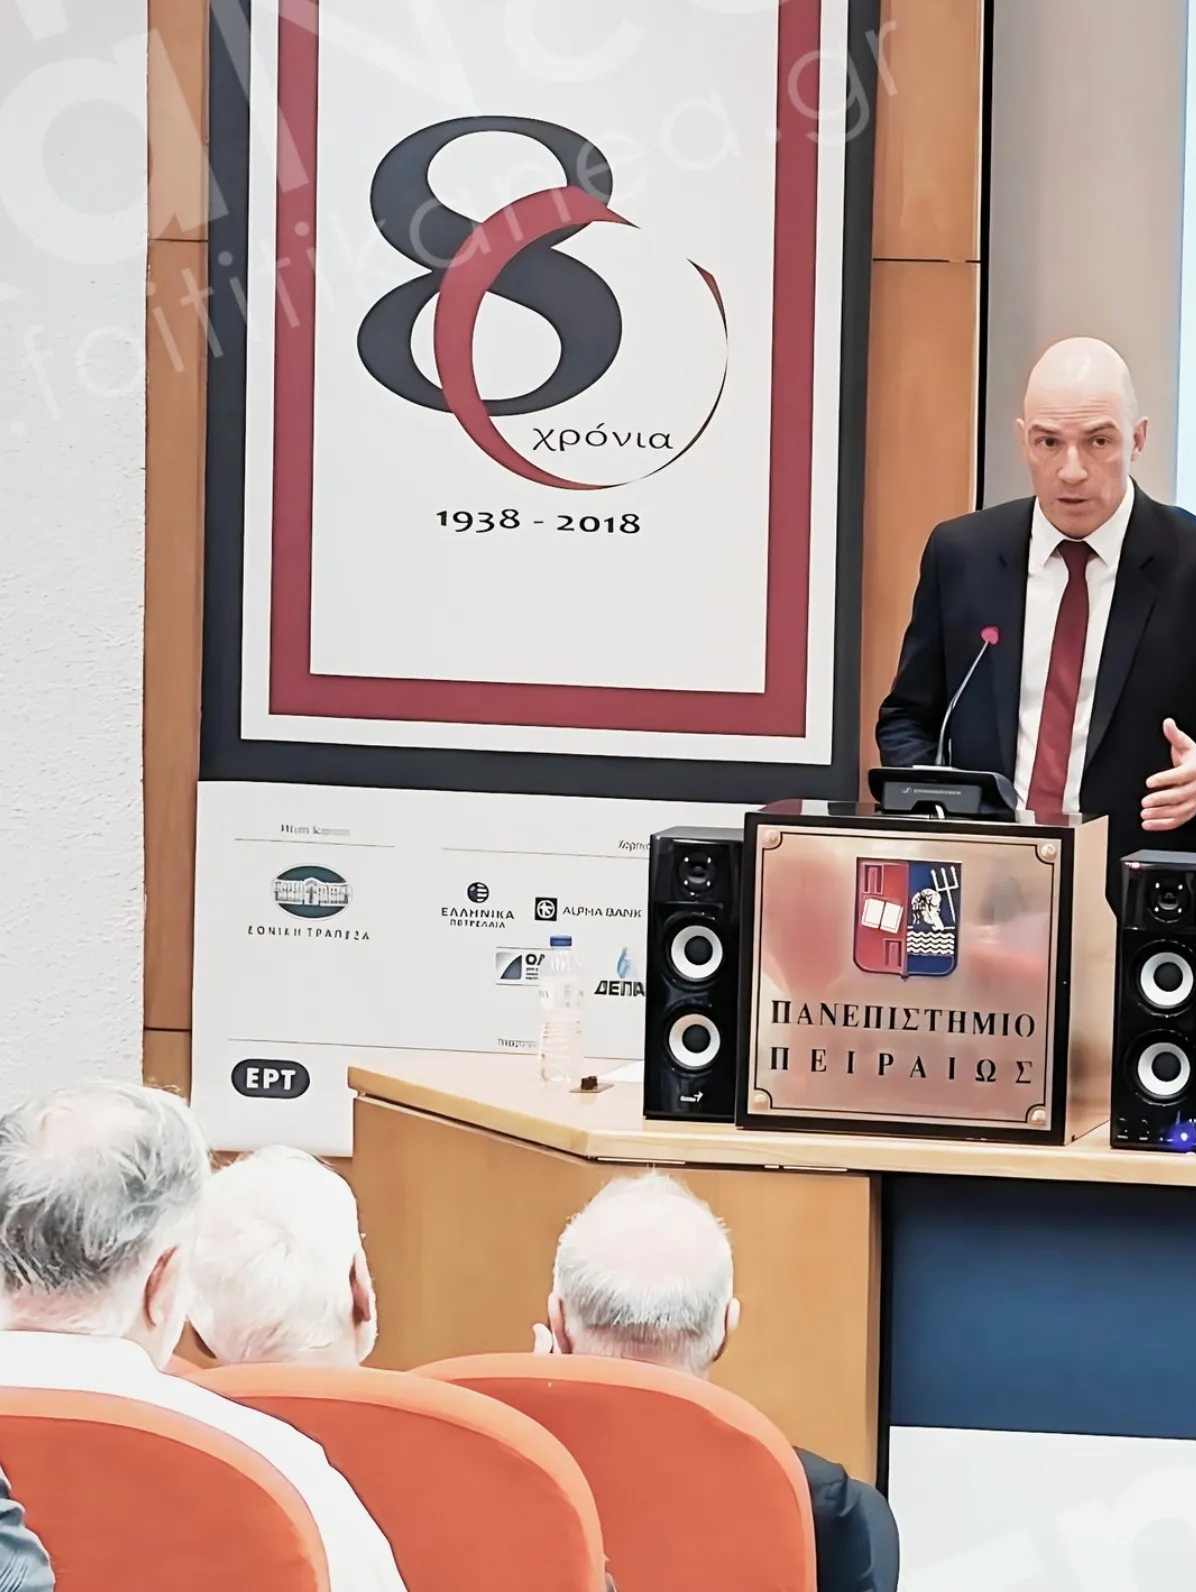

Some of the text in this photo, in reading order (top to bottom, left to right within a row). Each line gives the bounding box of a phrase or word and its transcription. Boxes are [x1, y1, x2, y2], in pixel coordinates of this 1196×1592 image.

[532, 423, 674, 451] χρόνια
[436, 508, 520, 533] 1938
[556, 513, 641, 534] 2018
[441, 907, 515, 919] ΕΛΛΗΝΙΚΑ
[562, 906, 642, 918] ALPHA BANK
[594, 980, 646, 997] ΔΕΠΑ
[771, 1000, 1036, 1038] ΠΑΝΕΠΙΣΤΗΜΙΟ
[770, 1046, 1034, 1084] ΠΕΙΡΑΙΩΣ
[246, 1067, 297, 1090] ΕΡΤ
